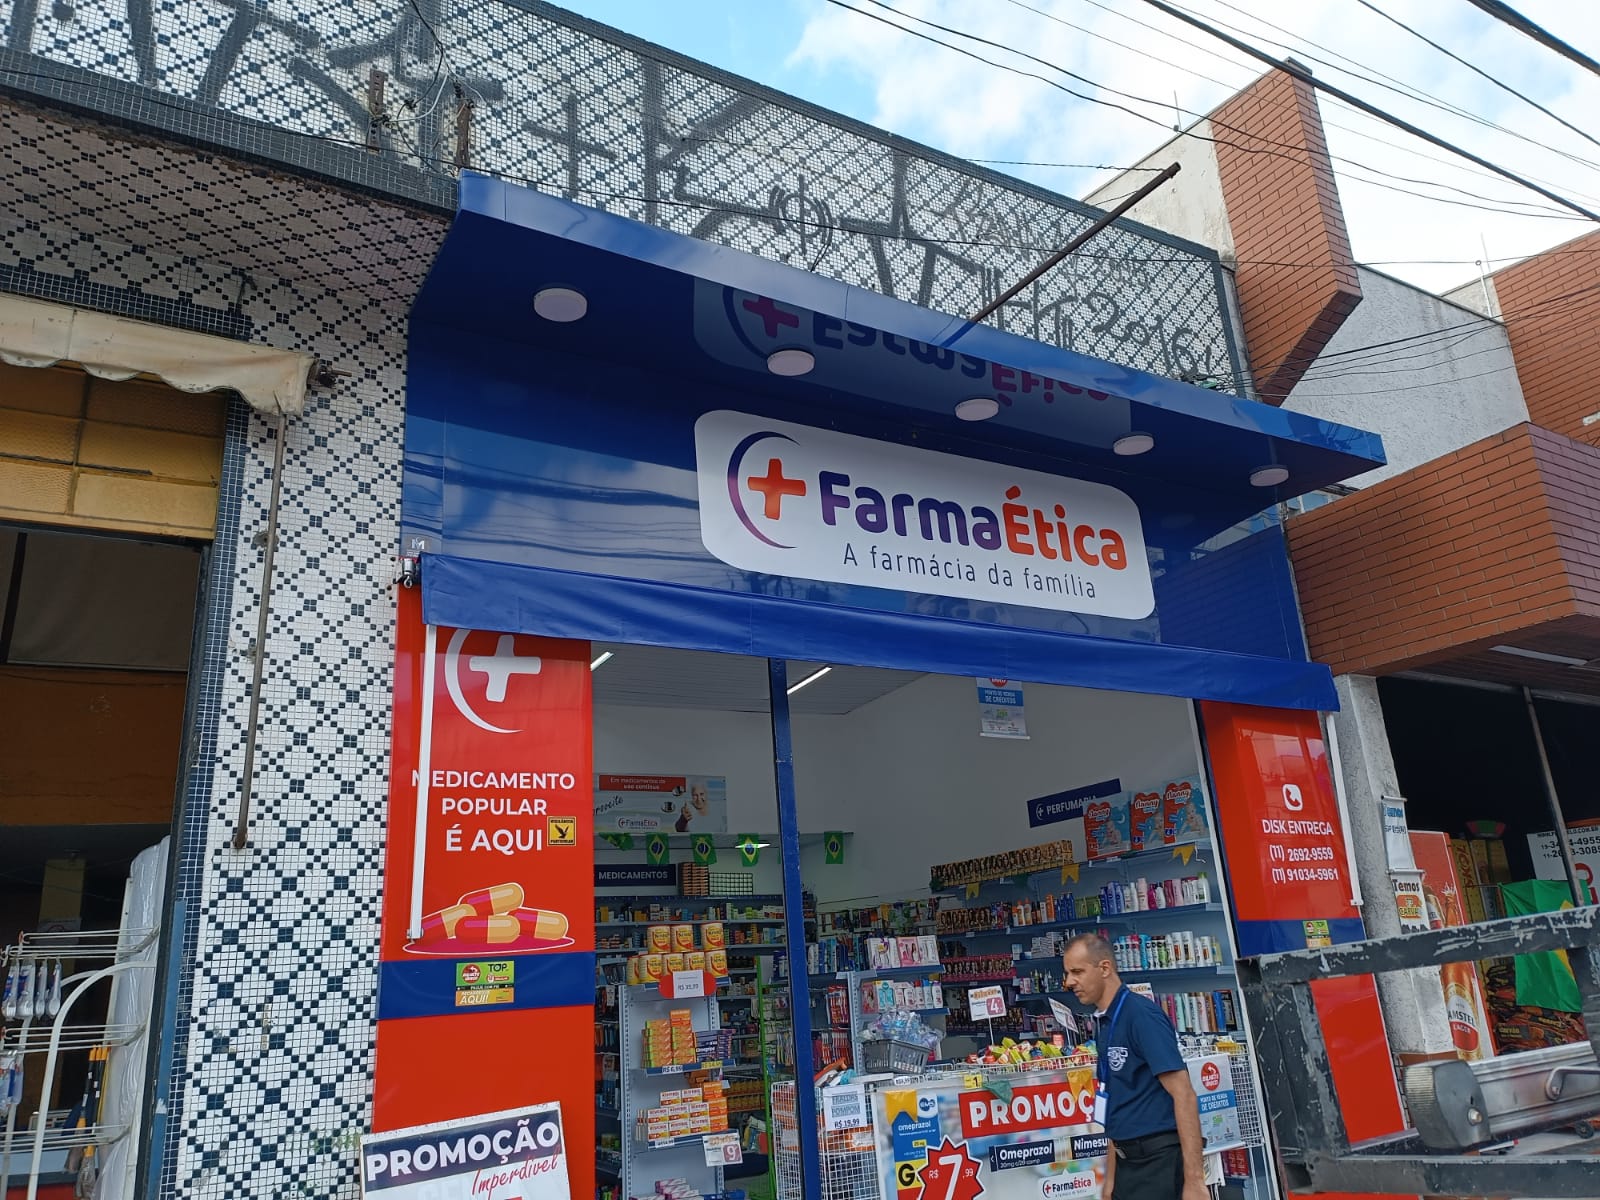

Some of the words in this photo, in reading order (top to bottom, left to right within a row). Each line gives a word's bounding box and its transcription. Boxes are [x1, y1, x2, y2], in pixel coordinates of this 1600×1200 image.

[818, 470, 1128, 571] FarmaÉtica
[843, 543, 858, 567] A
[869, 544, 976, 583] farmácia
[988, 562, 1014, 588] da
[1022, 566, 1097, 600] família
[441, 797, 548, 816] POPULAR
[1262, 818, 1288, 834] DISK
[1288, 820, 1335, 836] ENTREGA
[445, 824, 463, 852] É
[470, 828, 543, 856] AQUI
[1269, 844, 1285, 862] (11)
[1287, 847, 1334, 862] 2692-9559
[598, 871, 668, 880] MEDICAMENTOS
[1391, 879, 1420, 892] Temos
[488, 963, 508, 973] TOP
[1447, 1009, 1476, 1027] AMSTEL
[366, 1118, 560, 1182] PROMOÇÃO
[999, 1142, 1053, 1161] Omeprazol
[928, 1168, 939, 1179] R$
[1052, 1177, 1092, 1193] FarmaÉtica
